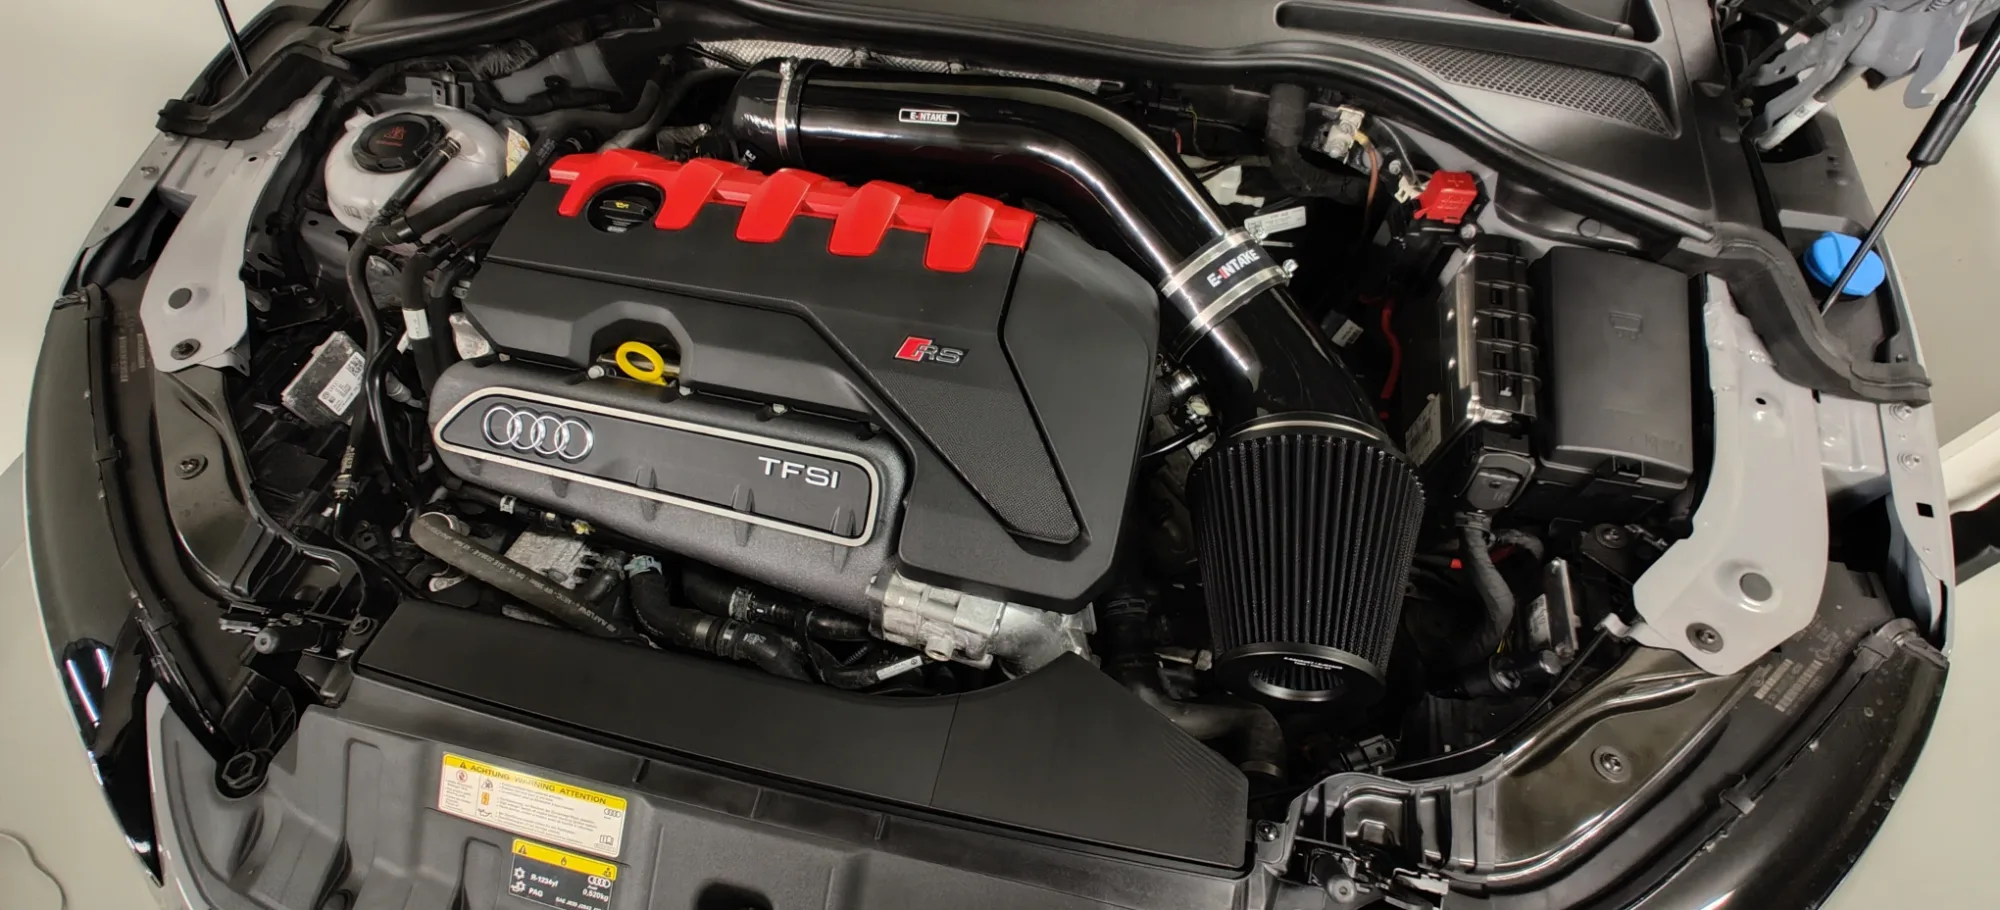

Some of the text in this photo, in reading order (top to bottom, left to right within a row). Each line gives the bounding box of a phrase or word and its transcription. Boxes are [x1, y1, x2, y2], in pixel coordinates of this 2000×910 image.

[1206, 248, 1261, 288] E-INTAKE
[902, 339, 964, 363] RS
[757, 456, 839, 489] TFSI
[470, 765, 510, 781] ACHTUNG
[514, 776, 556, 792] WARNING
[559, 787, 607, 805] ATTENTION
[528, 887, 544, 898] PAG
